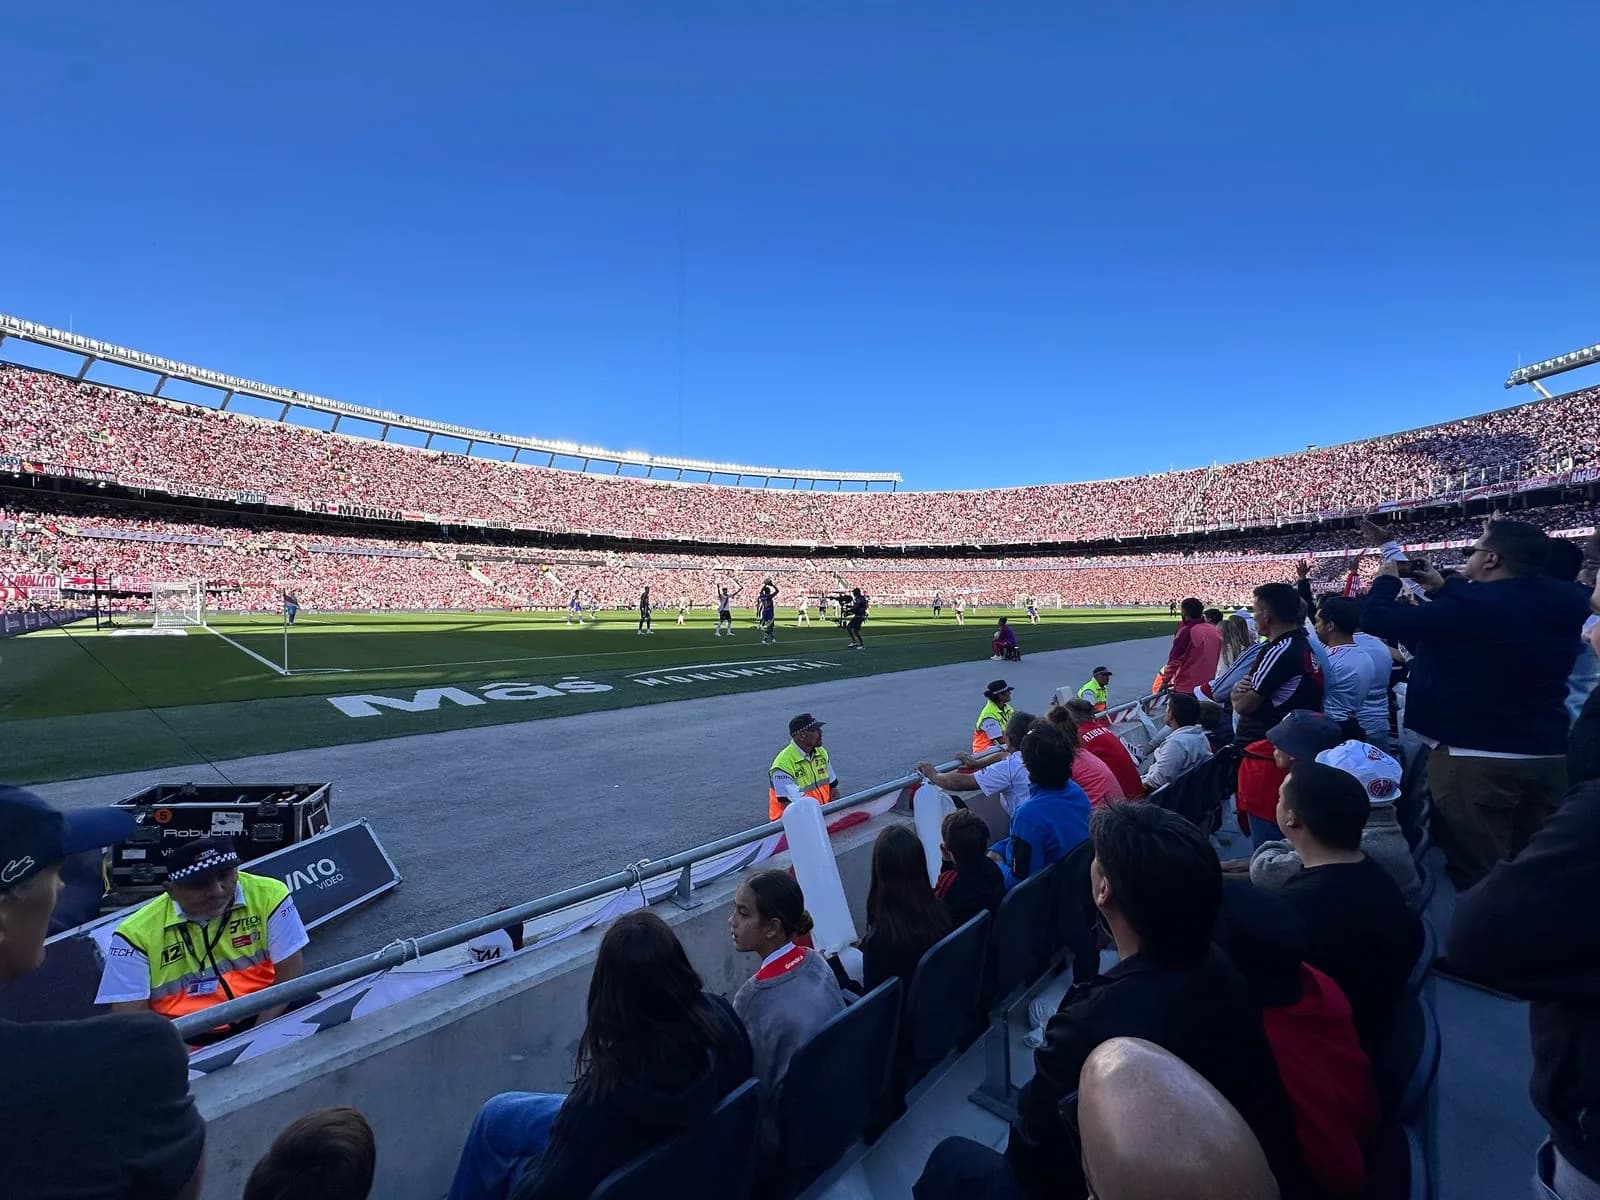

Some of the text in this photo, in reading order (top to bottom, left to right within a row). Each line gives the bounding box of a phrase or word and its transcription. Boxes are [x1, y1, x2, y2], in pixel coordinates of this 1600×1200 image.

[338, 504, 402, 520] MATANZA
[163, 828, 248, 839] Robycam
[316, 873, 344, 890] VIDEO
[162, 946, 182, 964] 12
